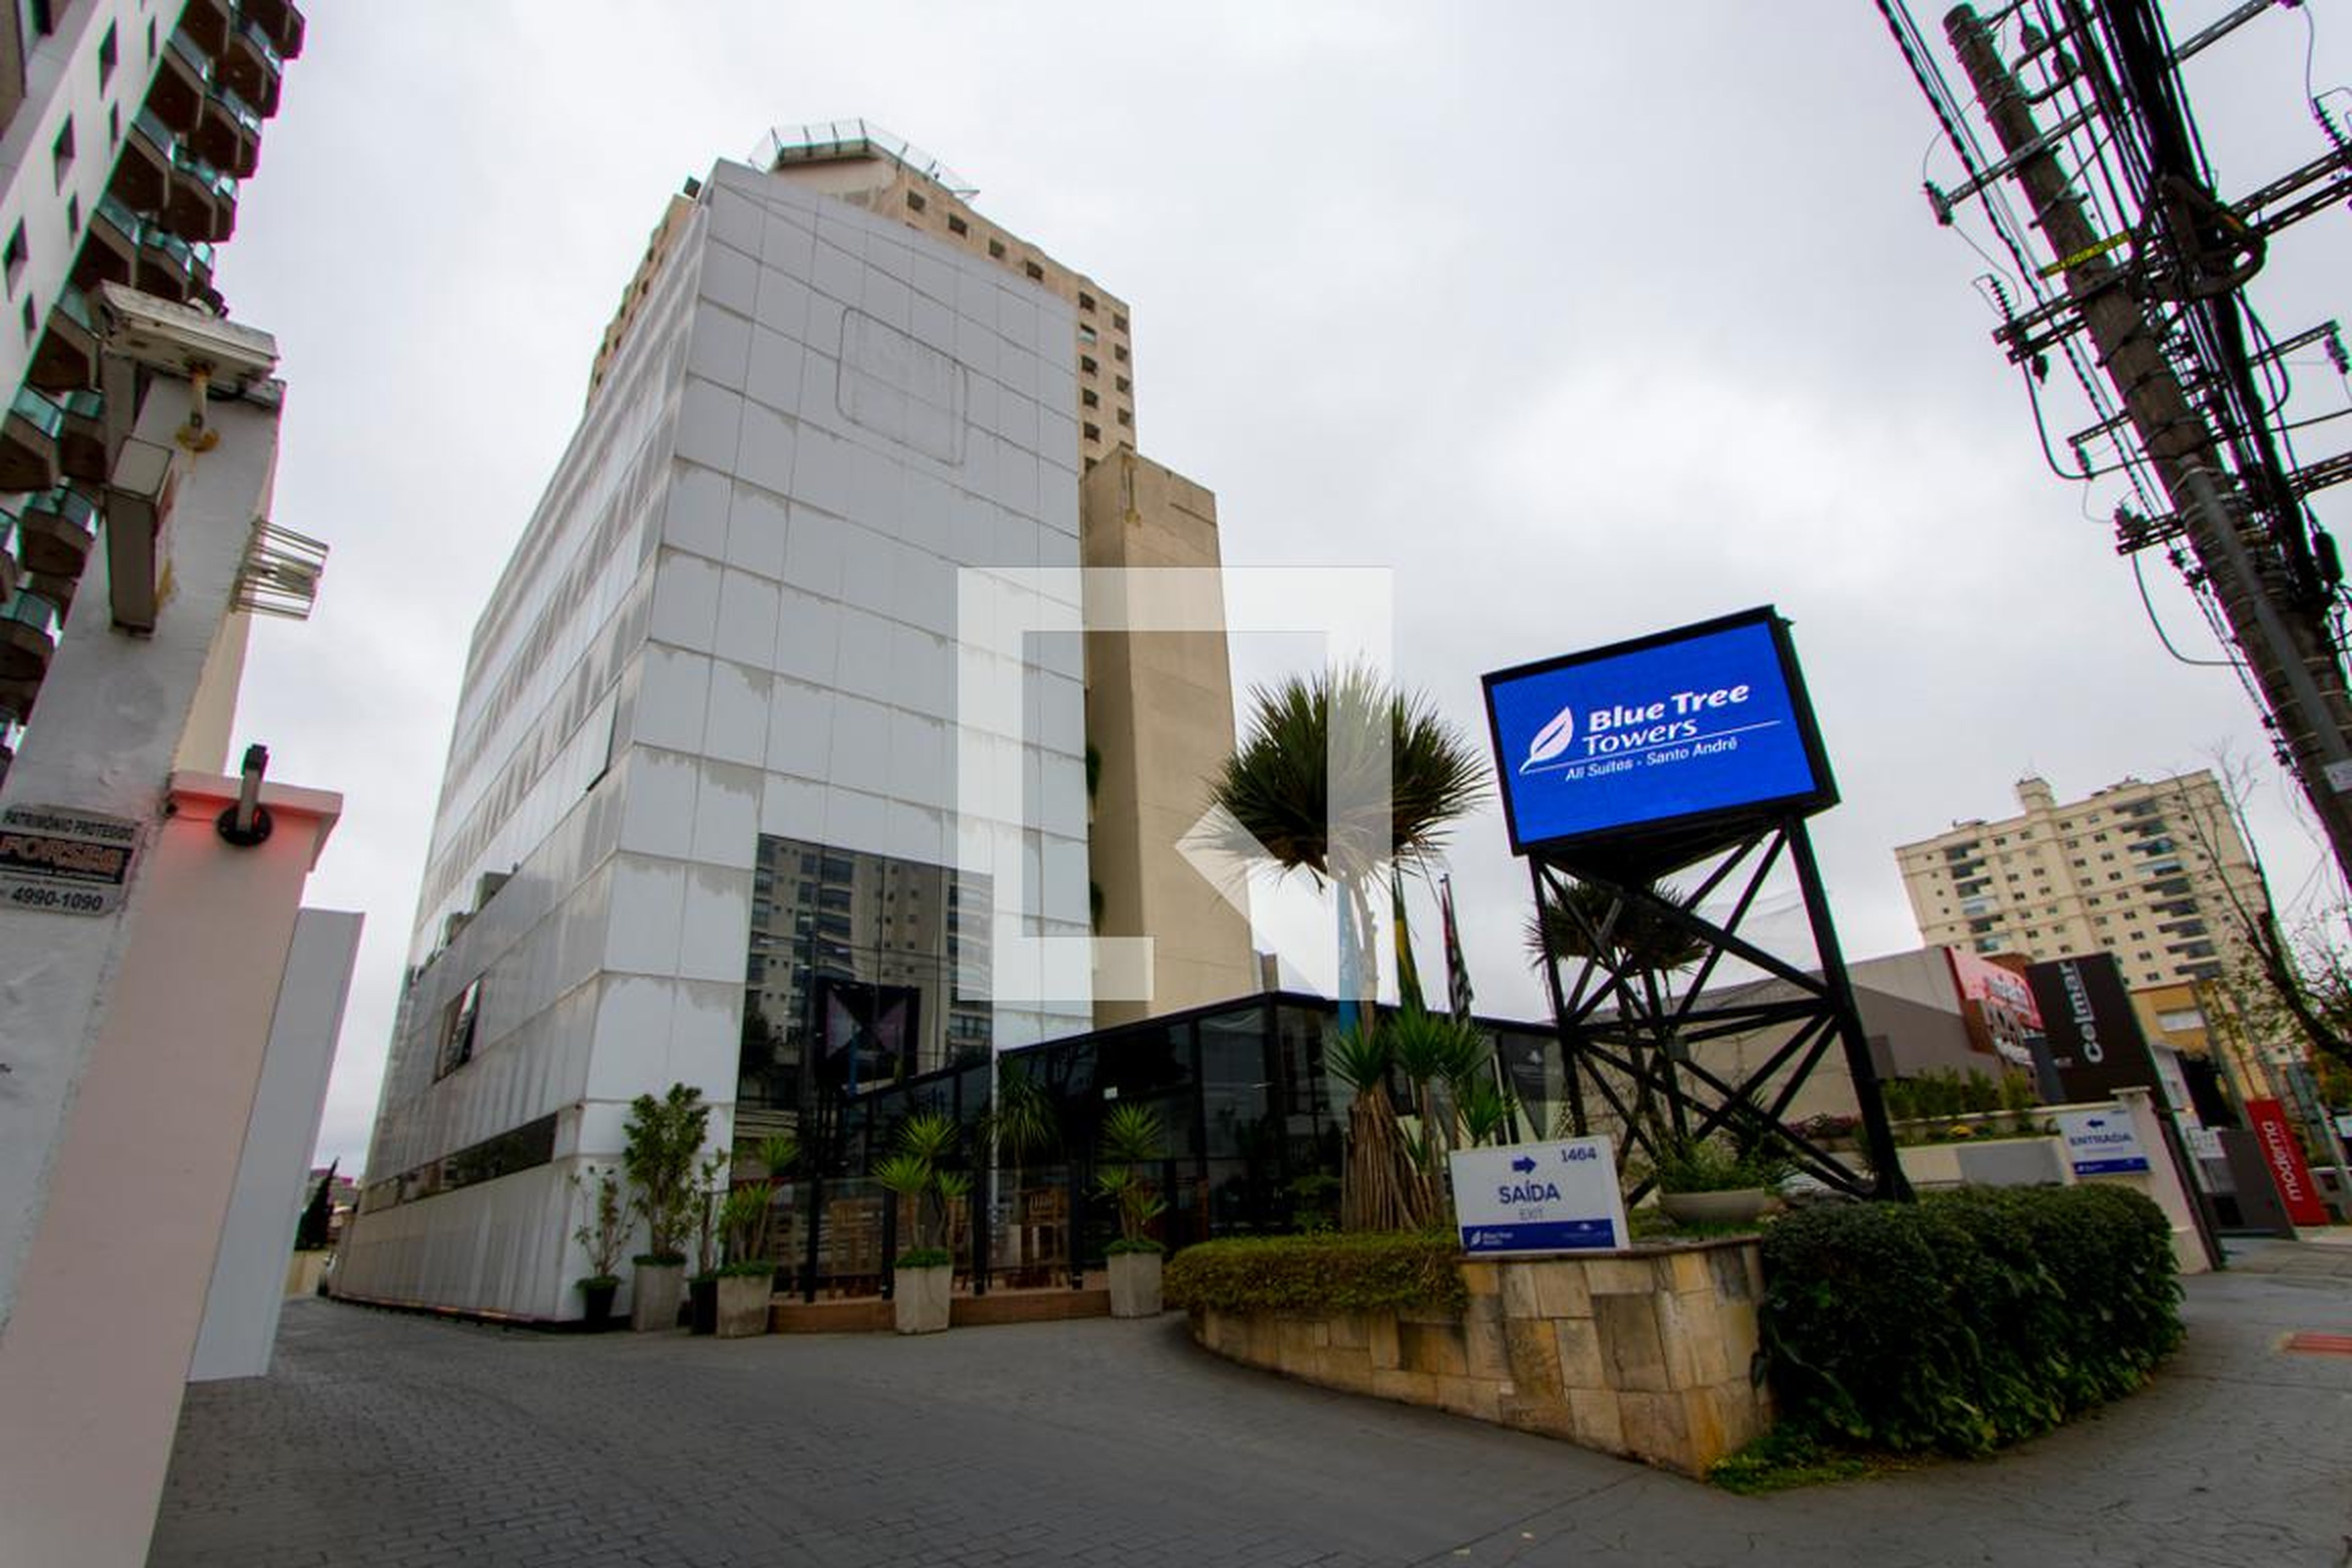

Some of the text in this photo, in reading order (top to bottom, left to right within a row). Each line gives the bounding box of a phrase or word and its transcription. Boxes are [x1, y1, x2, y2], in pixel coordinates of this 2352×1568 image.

[1589, 685, 1749, 733] Blue Tree
[1583, 718, 1698, 755] Towers
[1588, 758, 1634, 777] Suites
[1646, 747, 1689, 766] Santo
[1692, 737, 1738, 757] André
[11, 886, 104, 911] 4990-1090
[1561, 1147, 1597, 1163] 1464
[2262, 1120, 2304, 1202] moderna
[1498, 1180, 1561, 1204] SAÍDA
